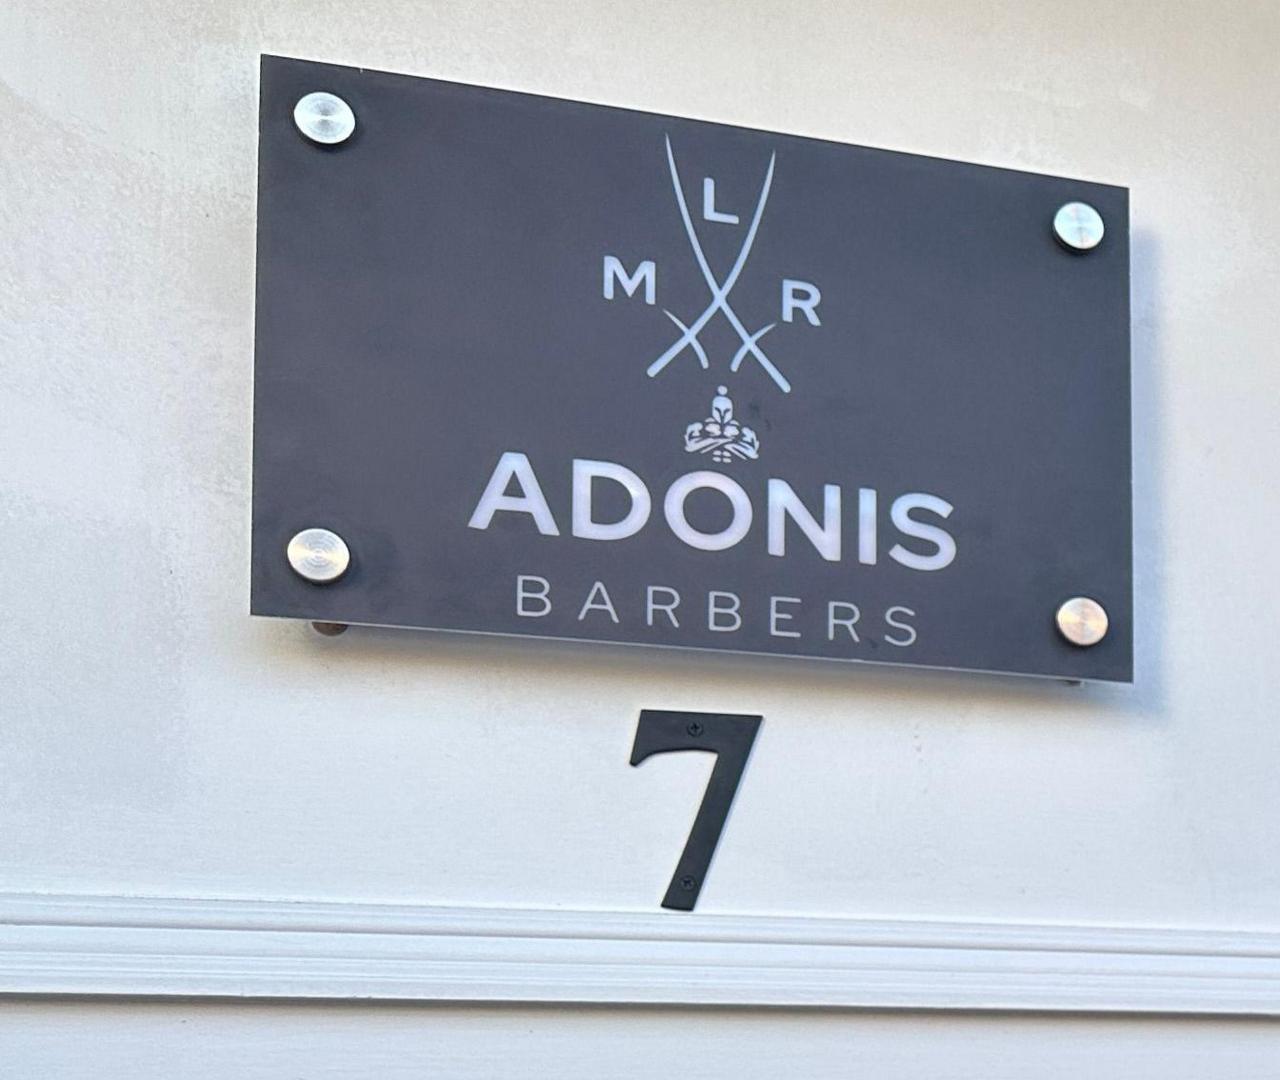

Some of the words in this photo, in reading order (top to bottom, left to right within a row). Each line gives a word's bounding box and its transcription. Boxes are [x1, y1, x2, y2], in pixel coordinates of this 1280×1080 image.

[703, 177, 740, 224] L
[603, 255, 657, 305] M
[781, 278, 822, 327] R
[467, 451, 957, 572] ADONIS
[516, 574, 918, 647] BARBERS
[629, 709, 764, 912] 7
